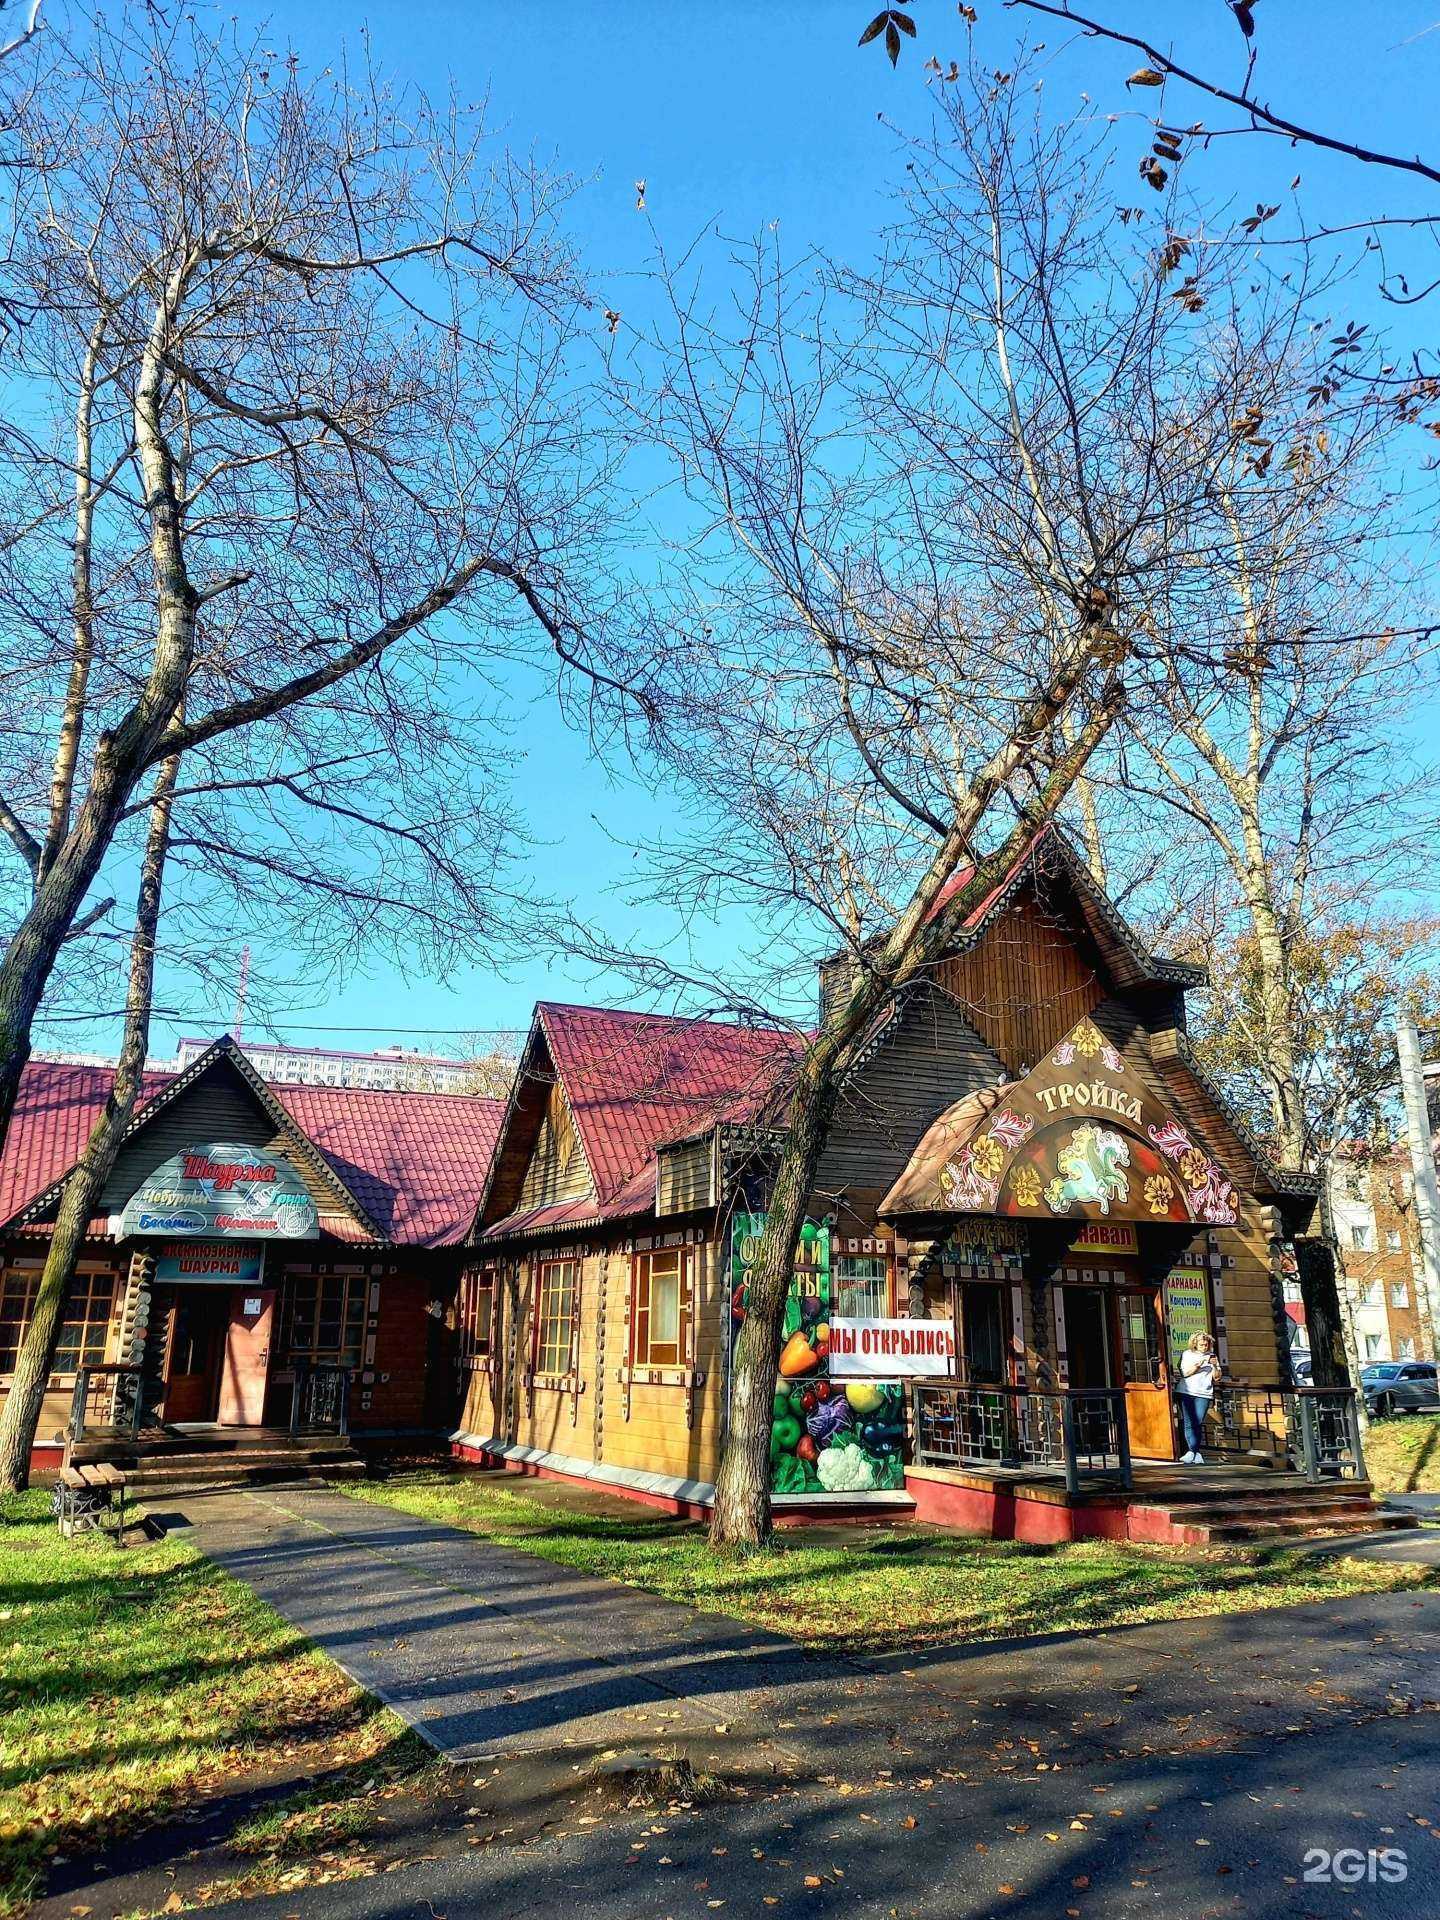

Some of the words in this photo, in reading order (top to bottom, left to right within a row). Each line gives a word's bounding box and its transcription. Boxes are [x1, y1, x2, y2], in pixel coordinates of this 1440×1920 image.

[1036, 1079, 1143, 1125] ТРОЙКА
[183, 1155, 277, 1189] Шаурма
[271, 1190, 309, 1206] Гриль
[139, 1214, 193, 1229] Беляши
[215, 1215, 278, 1230] Шашлык
[161, 1244, 259, 1259] ЭКСКЛЮЗИВНАЯ
[179, 1260, 240, 1274] ШАУРМА
[829, 1327, 856, 1353] МЫ
[861, 1328, 955, 1356] ОТКРЫЛИСЬ
